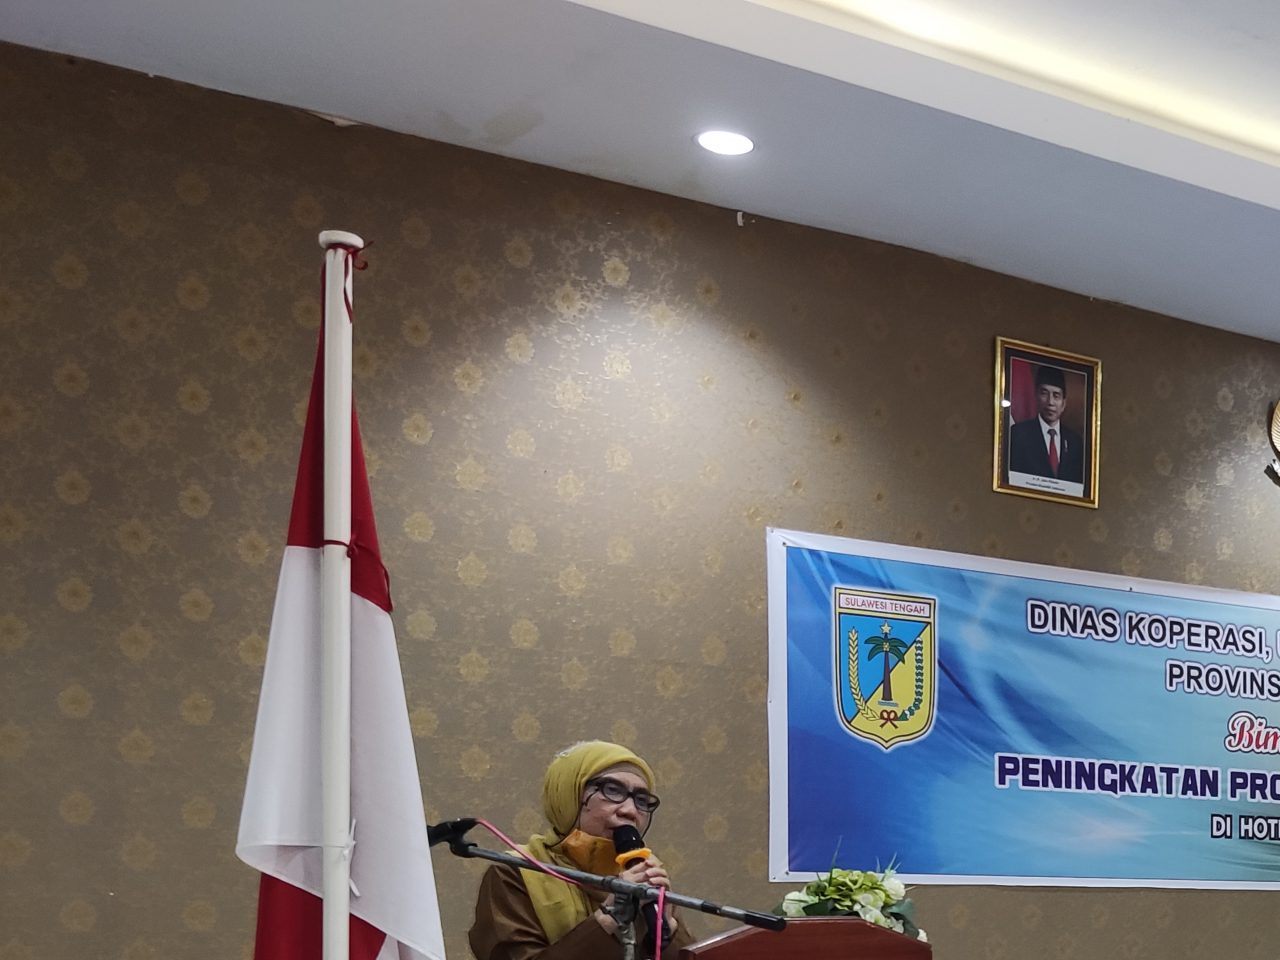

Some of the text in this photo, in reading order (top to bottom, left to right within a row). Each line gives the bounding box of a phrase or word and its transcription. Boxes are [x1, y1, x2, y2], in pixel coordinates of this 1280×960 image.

[845, 597, 926, 614] SULAWESI TENGAH
[1028, 602, 1119, 638] DINAS
[1127, 614, 1271, 663] KOPERASI,
[997, 755, 1219, 797] PENINGKATAN
[1211, 814, 1231, 837] DI
